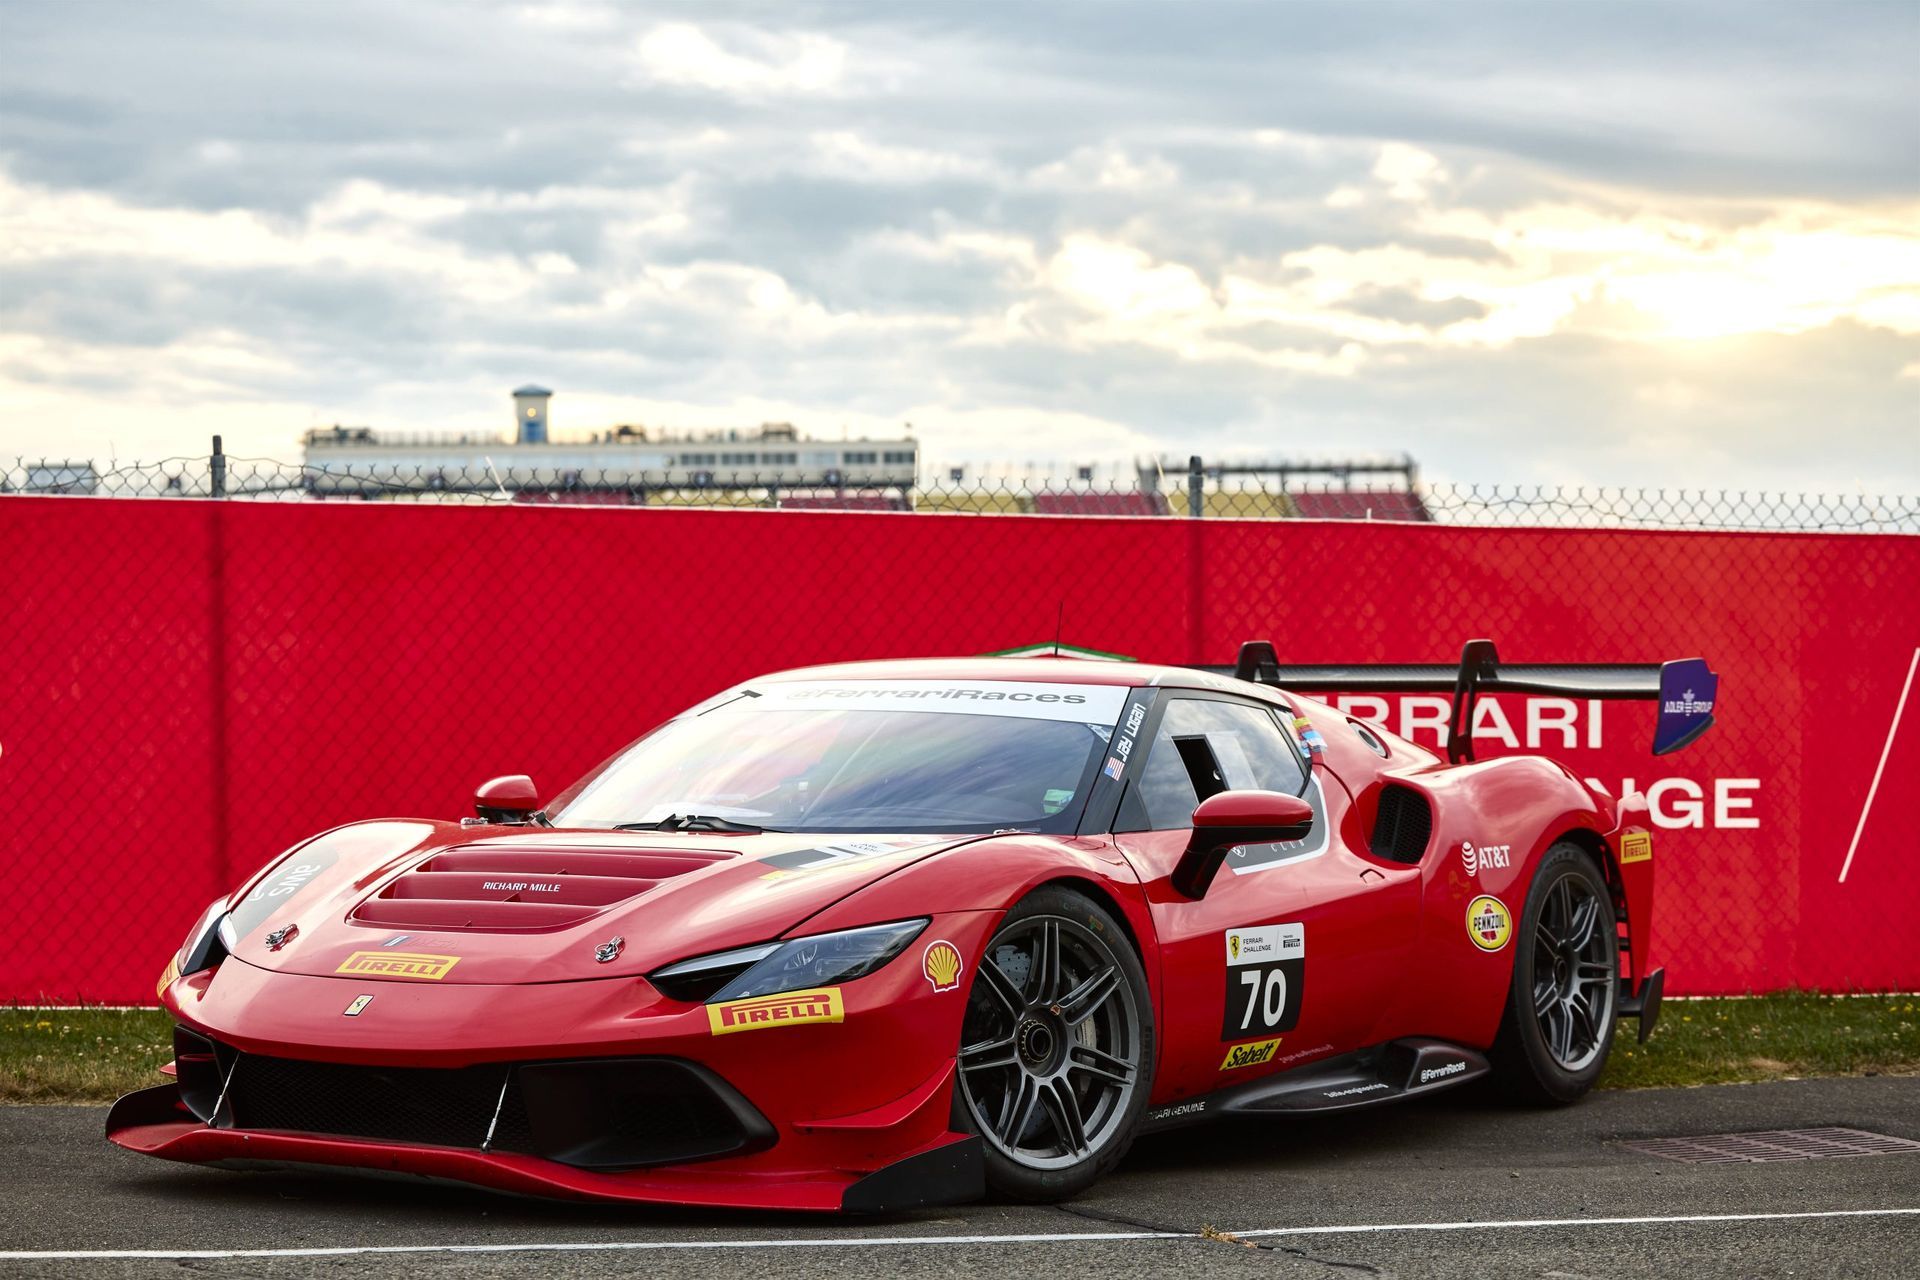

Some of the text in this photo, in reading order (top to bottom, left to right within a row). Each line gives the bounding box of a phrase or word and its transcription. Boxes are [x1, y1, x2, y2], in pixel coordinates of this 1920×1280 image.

[786, 688, 1086, 704] @FerrariRaces
[1664, 701, 1713, 713] ADLER GROUP
[1624, 837, 1649, 858] PIRELLI
[1479, 845, 1510, 869] AT&T
[482, 881, 561, 892] RICHARD MILLE
[1473, 914, 1505, 931] PENNZOIL
[1243, 937, 1263, 945] FERRARI
[1243, 944, 1272, 953] CHALLENGE
[1283, 938, 1301, 949] PIRELLI
[345, 955, 450, 976] PIRELLI
[1240, 968, 1287, 1030] 70
[720, 994, 832, 1027] PIRELLI
[1226, 1042, 1275, 1068] Sabelt
[1421, 1062, 1466, 1083] @FerrariRaces
[1171, 1101, 1206, 1116] GENUINE
